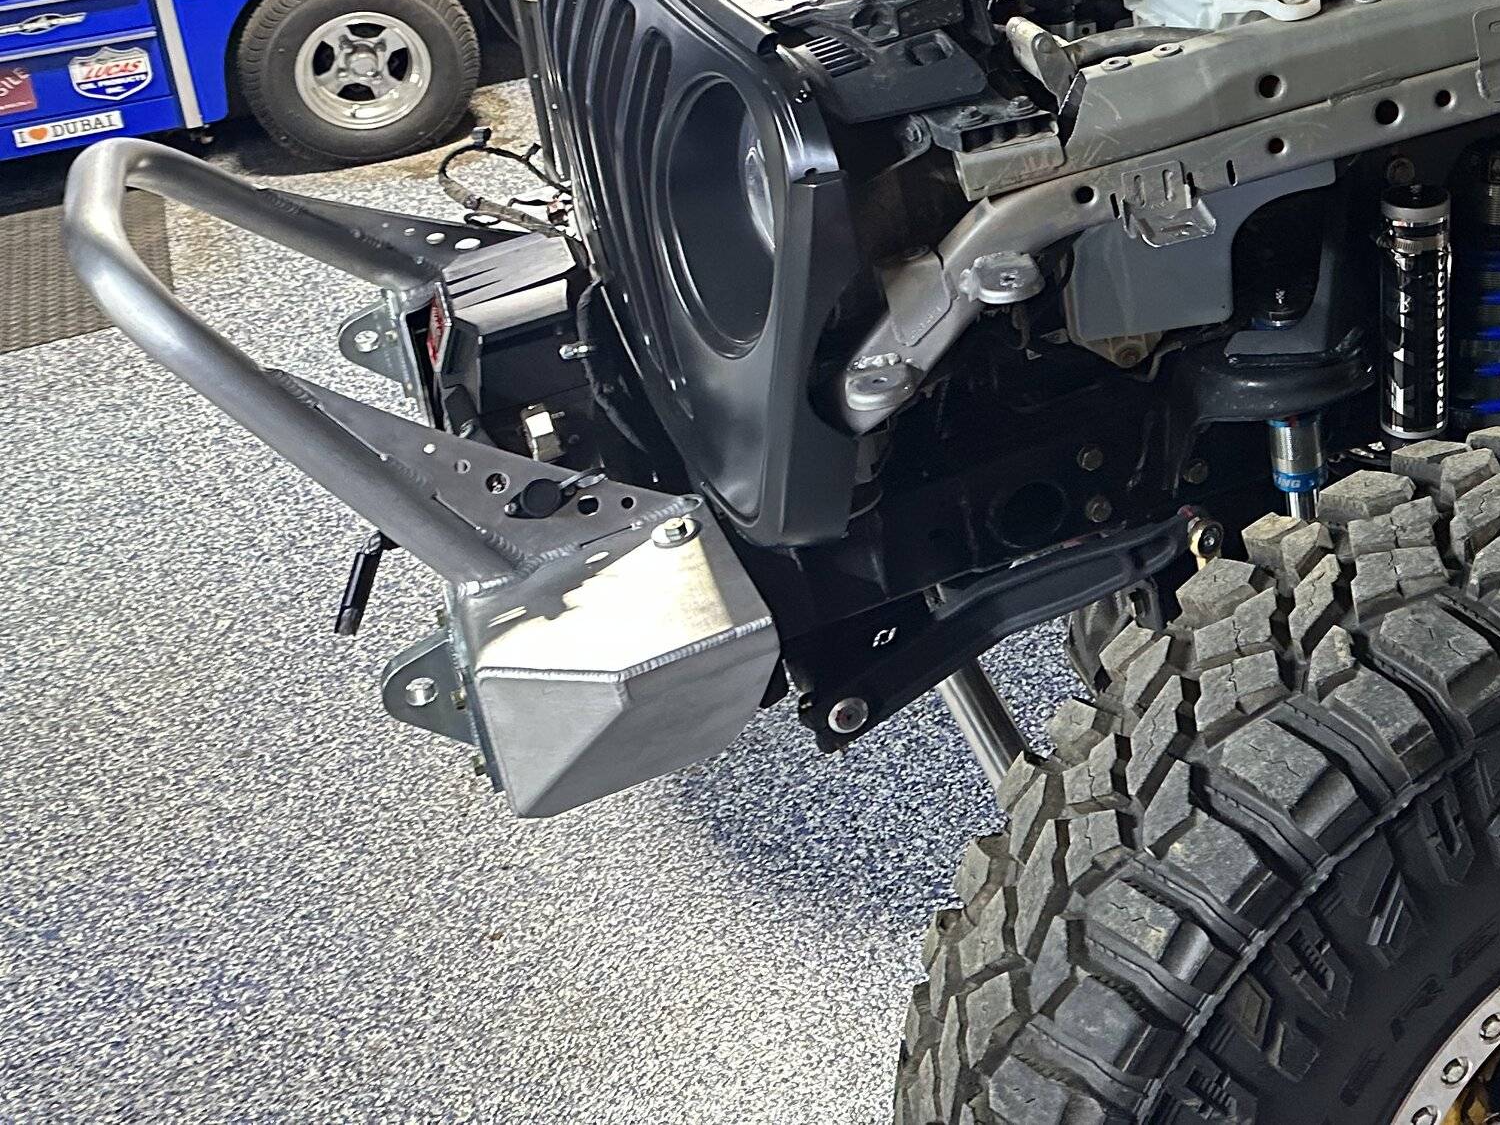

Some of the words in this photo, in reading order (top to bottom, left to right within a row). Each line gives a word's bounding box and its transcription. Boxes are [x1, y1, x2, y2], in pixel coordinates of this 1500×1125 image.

[84, 60, 142, 80] LUCAS
[18, 131, 27, 144] I
[51, 114, 118, 137] DUBAI
